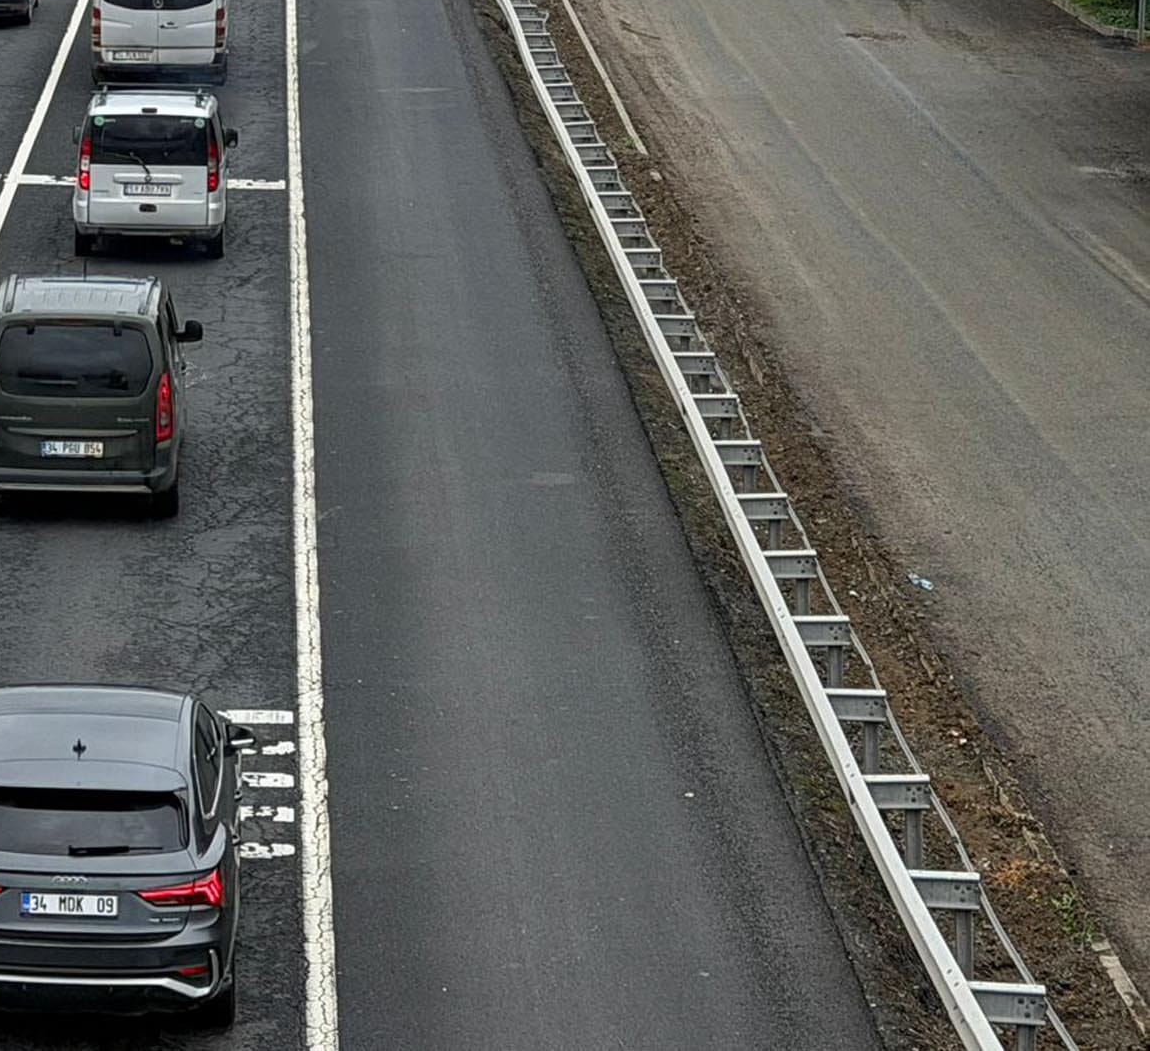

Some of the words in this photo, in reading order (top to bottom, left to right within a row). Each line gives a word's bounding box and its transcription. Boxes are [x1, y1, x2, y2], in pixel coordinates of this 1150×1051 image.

[31, 895, 48, 911] 34
[58, 896, 84, 912] MDK
[96, 897, 114, 913] 09
